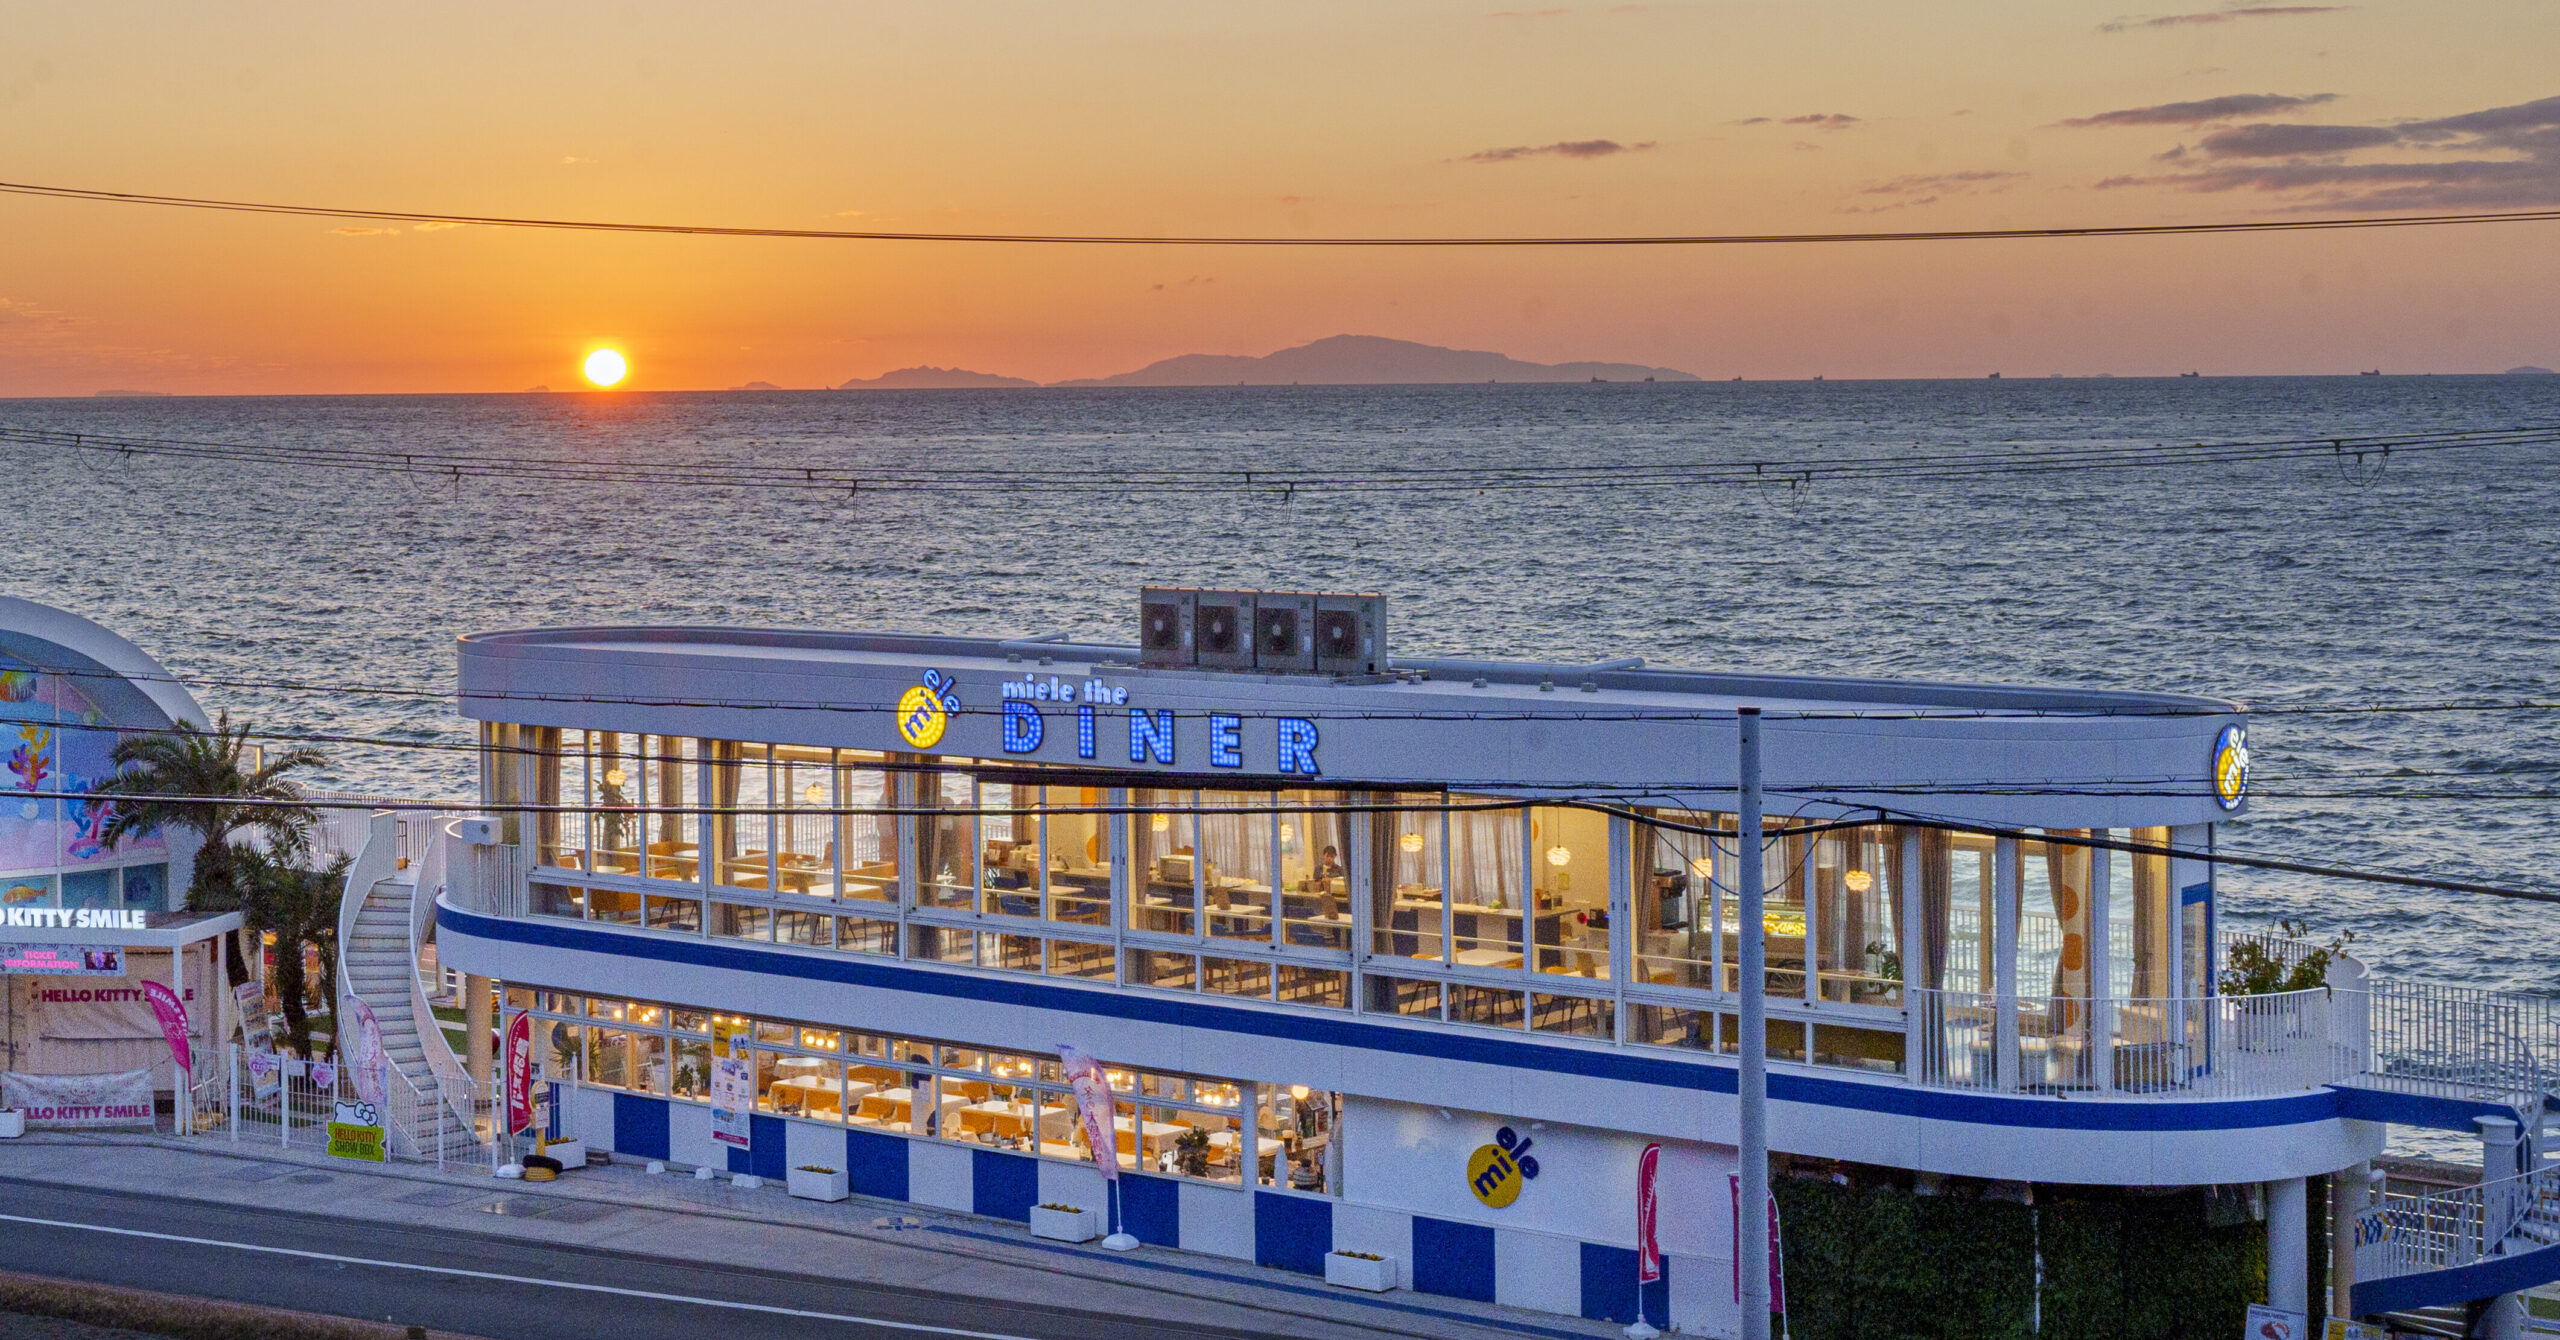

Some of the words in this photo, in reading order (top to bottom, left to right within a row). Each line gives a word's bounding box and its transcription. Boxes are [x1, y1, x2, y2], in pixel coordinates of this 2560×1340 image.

[1002, 673, 1076, 703] miele
[1083, 677, 1129, 706] the
[1002, 700, 1320, 774] DINER
[7, 907, 74, 928] KITTY
[76, 908, 146, 930] SMILE
[24, 950, 57, 960] TICKET
[5, 959, 79, 970] INFORMATION
[41, 988, 92, 1003] HELLO
[95, 988, 142, 1003] KITTY
[24, 1106, 54, 1120] LLO
[57, 1106, 101, 1120] KITTY
[104, 1104, 150, 1118] SMILE
[335, 1127, 356, 1141] HELLO
[357, 1130, 377, 1144] KITTY
[335, 1139, 358, 1153] SHOW
[360, 1143, 375, 1155] BOX
